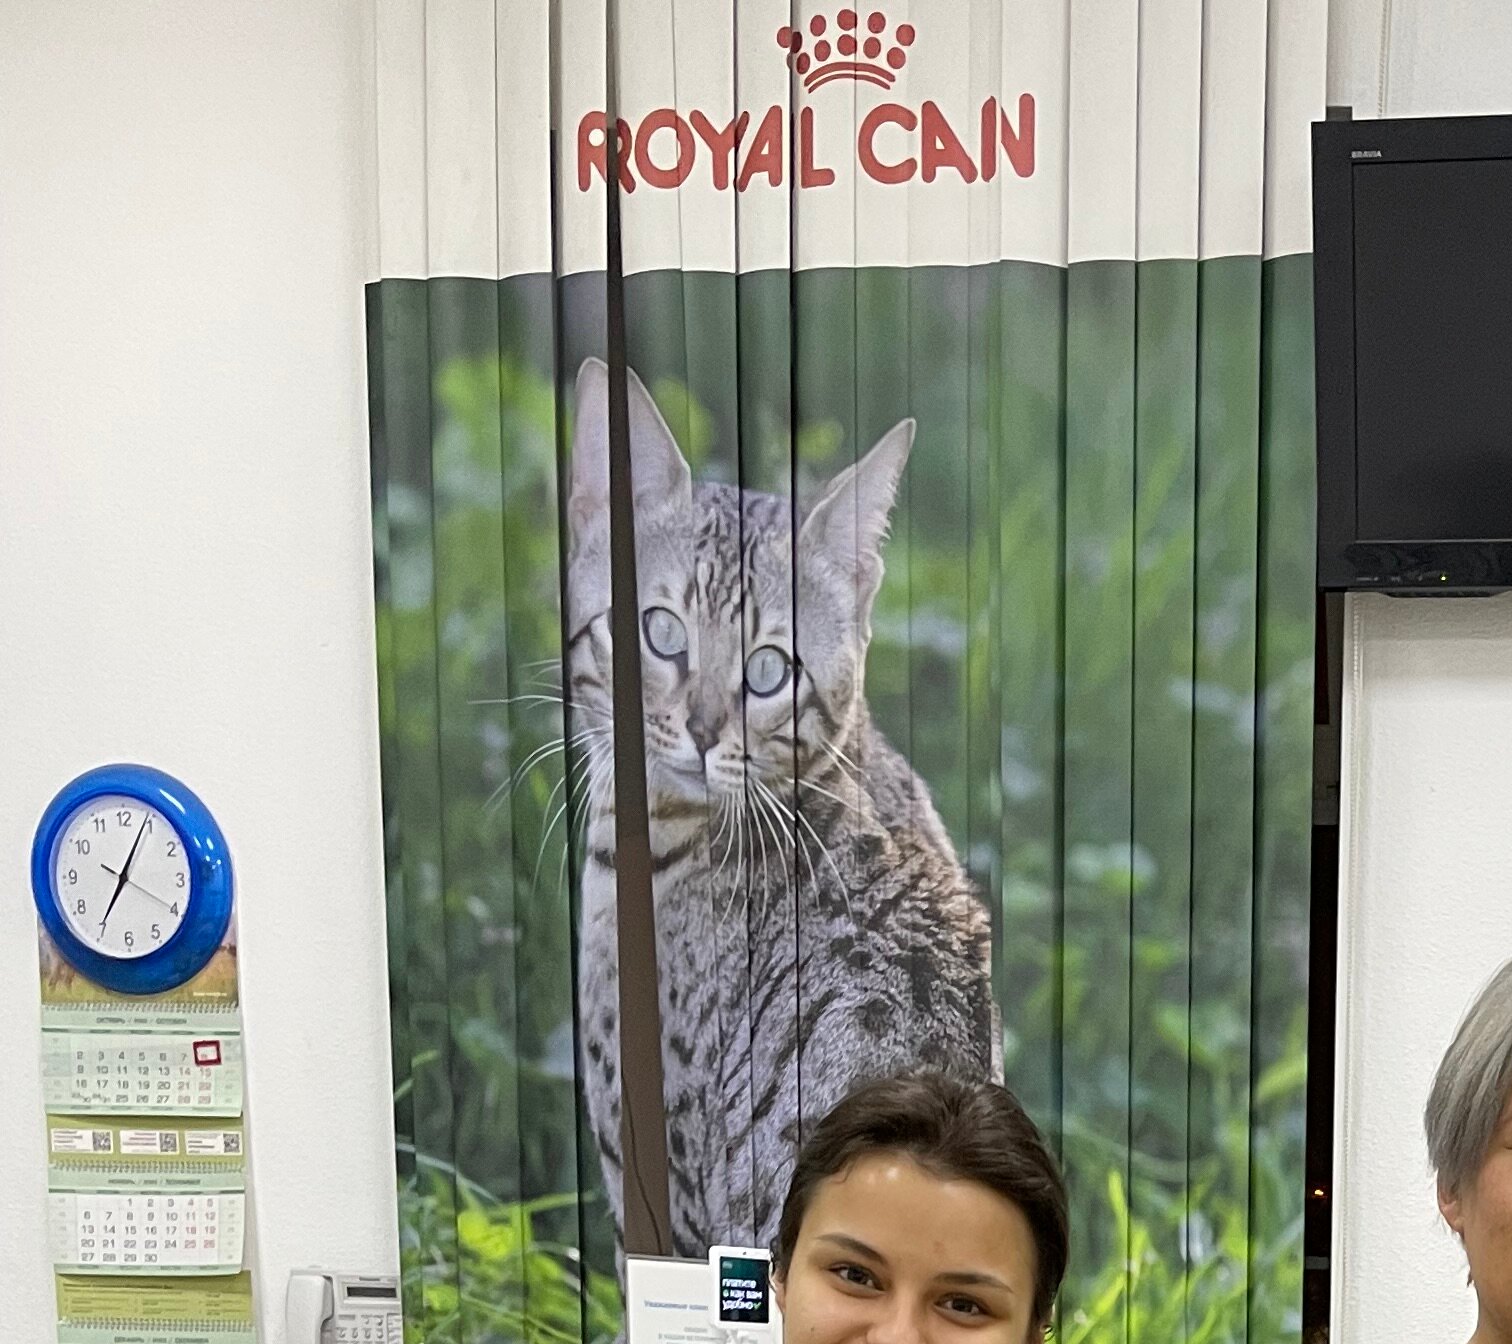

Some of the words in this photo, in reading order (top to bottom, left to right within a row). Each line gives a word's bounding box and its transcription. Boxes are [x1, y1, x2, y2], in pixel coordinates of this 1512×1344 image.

[578, 105, 835, 194] ROYAL
[94, 819, 106, 832] 11
[117, 812, 131, 826] 12
[75, 840, 90, 854] 10
[167, 841, 176, 856] 2
[69, 869, 77, 884] 9
[176, 873, 185, 887] 3
[77, 899, 86, 914] 8
[169, 902, 178, 916] 4
[99, 922, 107, 938] 7
[151, 924, 160, 939] 5
[125, 932, 133, 946] 6
